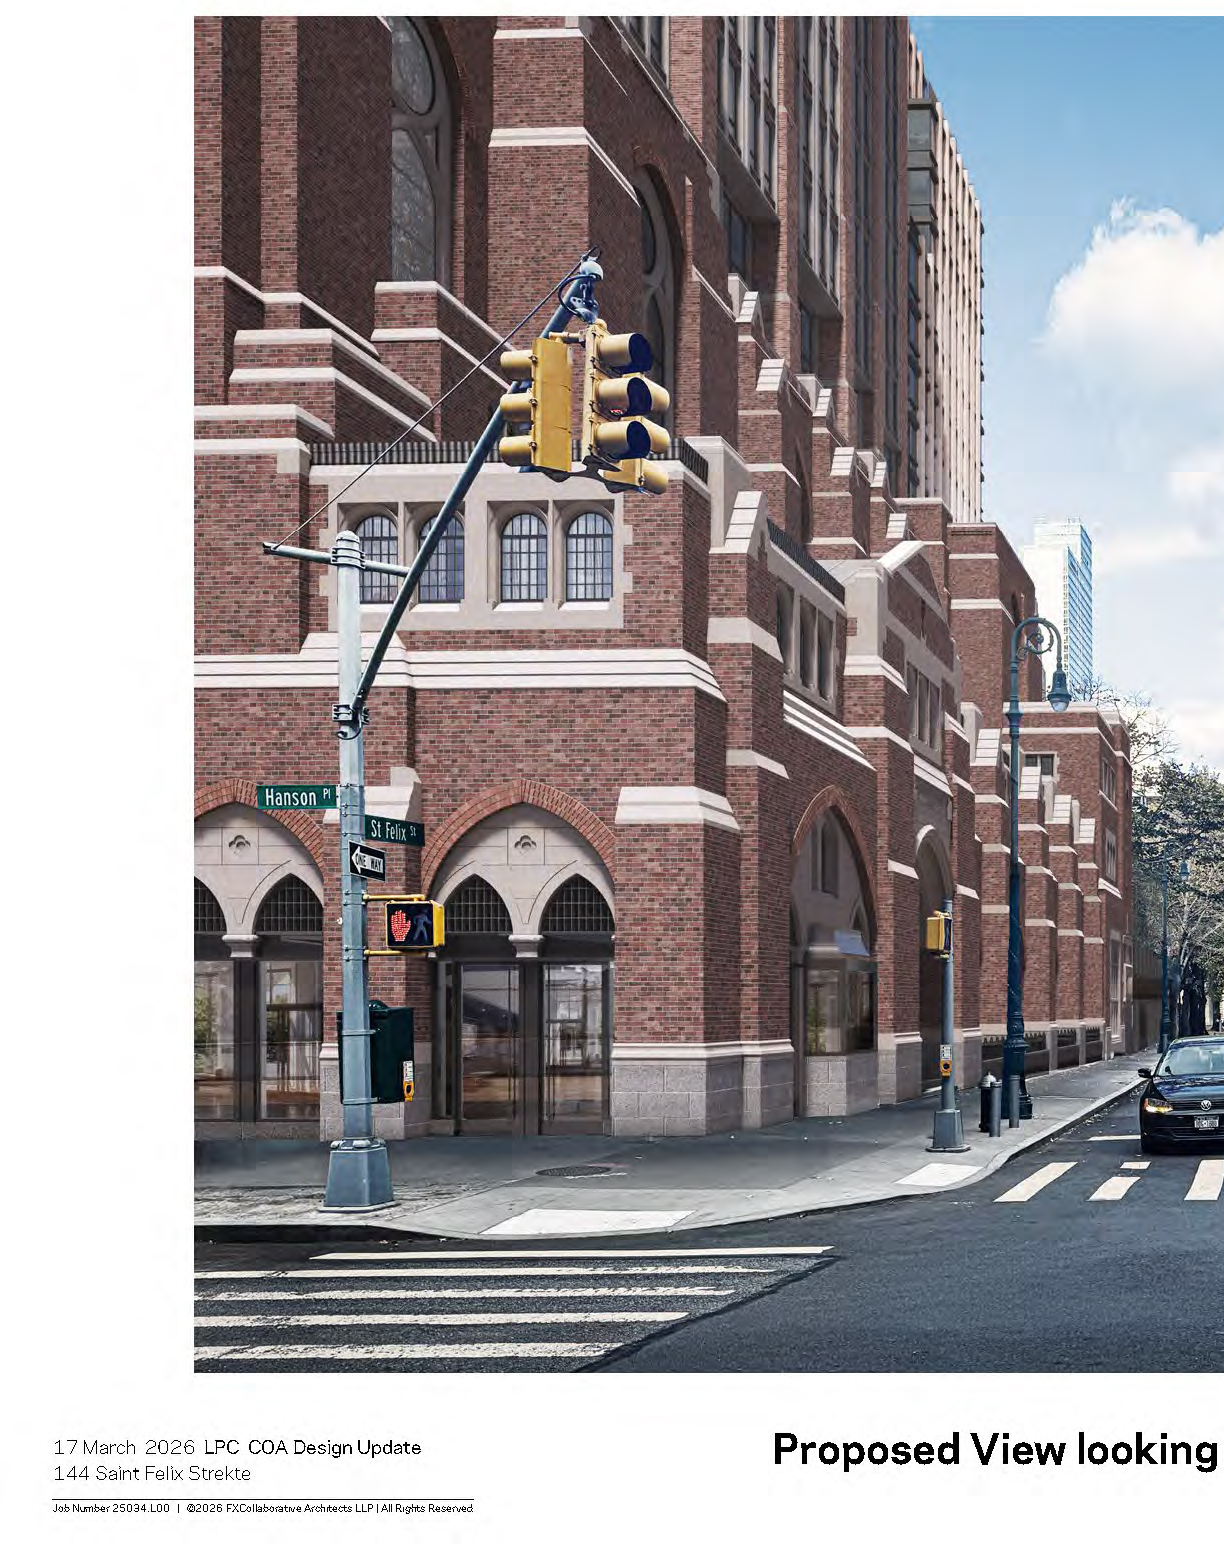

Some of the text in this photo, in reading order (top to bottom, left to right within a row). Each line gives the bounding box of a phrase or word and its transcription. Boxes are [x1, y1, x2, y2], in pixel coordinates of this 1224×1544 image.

[265, 788, 331, 806] Hanson Pl
[371, 820, 417, 841] St Felix St
[355, 853, 382, 873] ONE WAY
